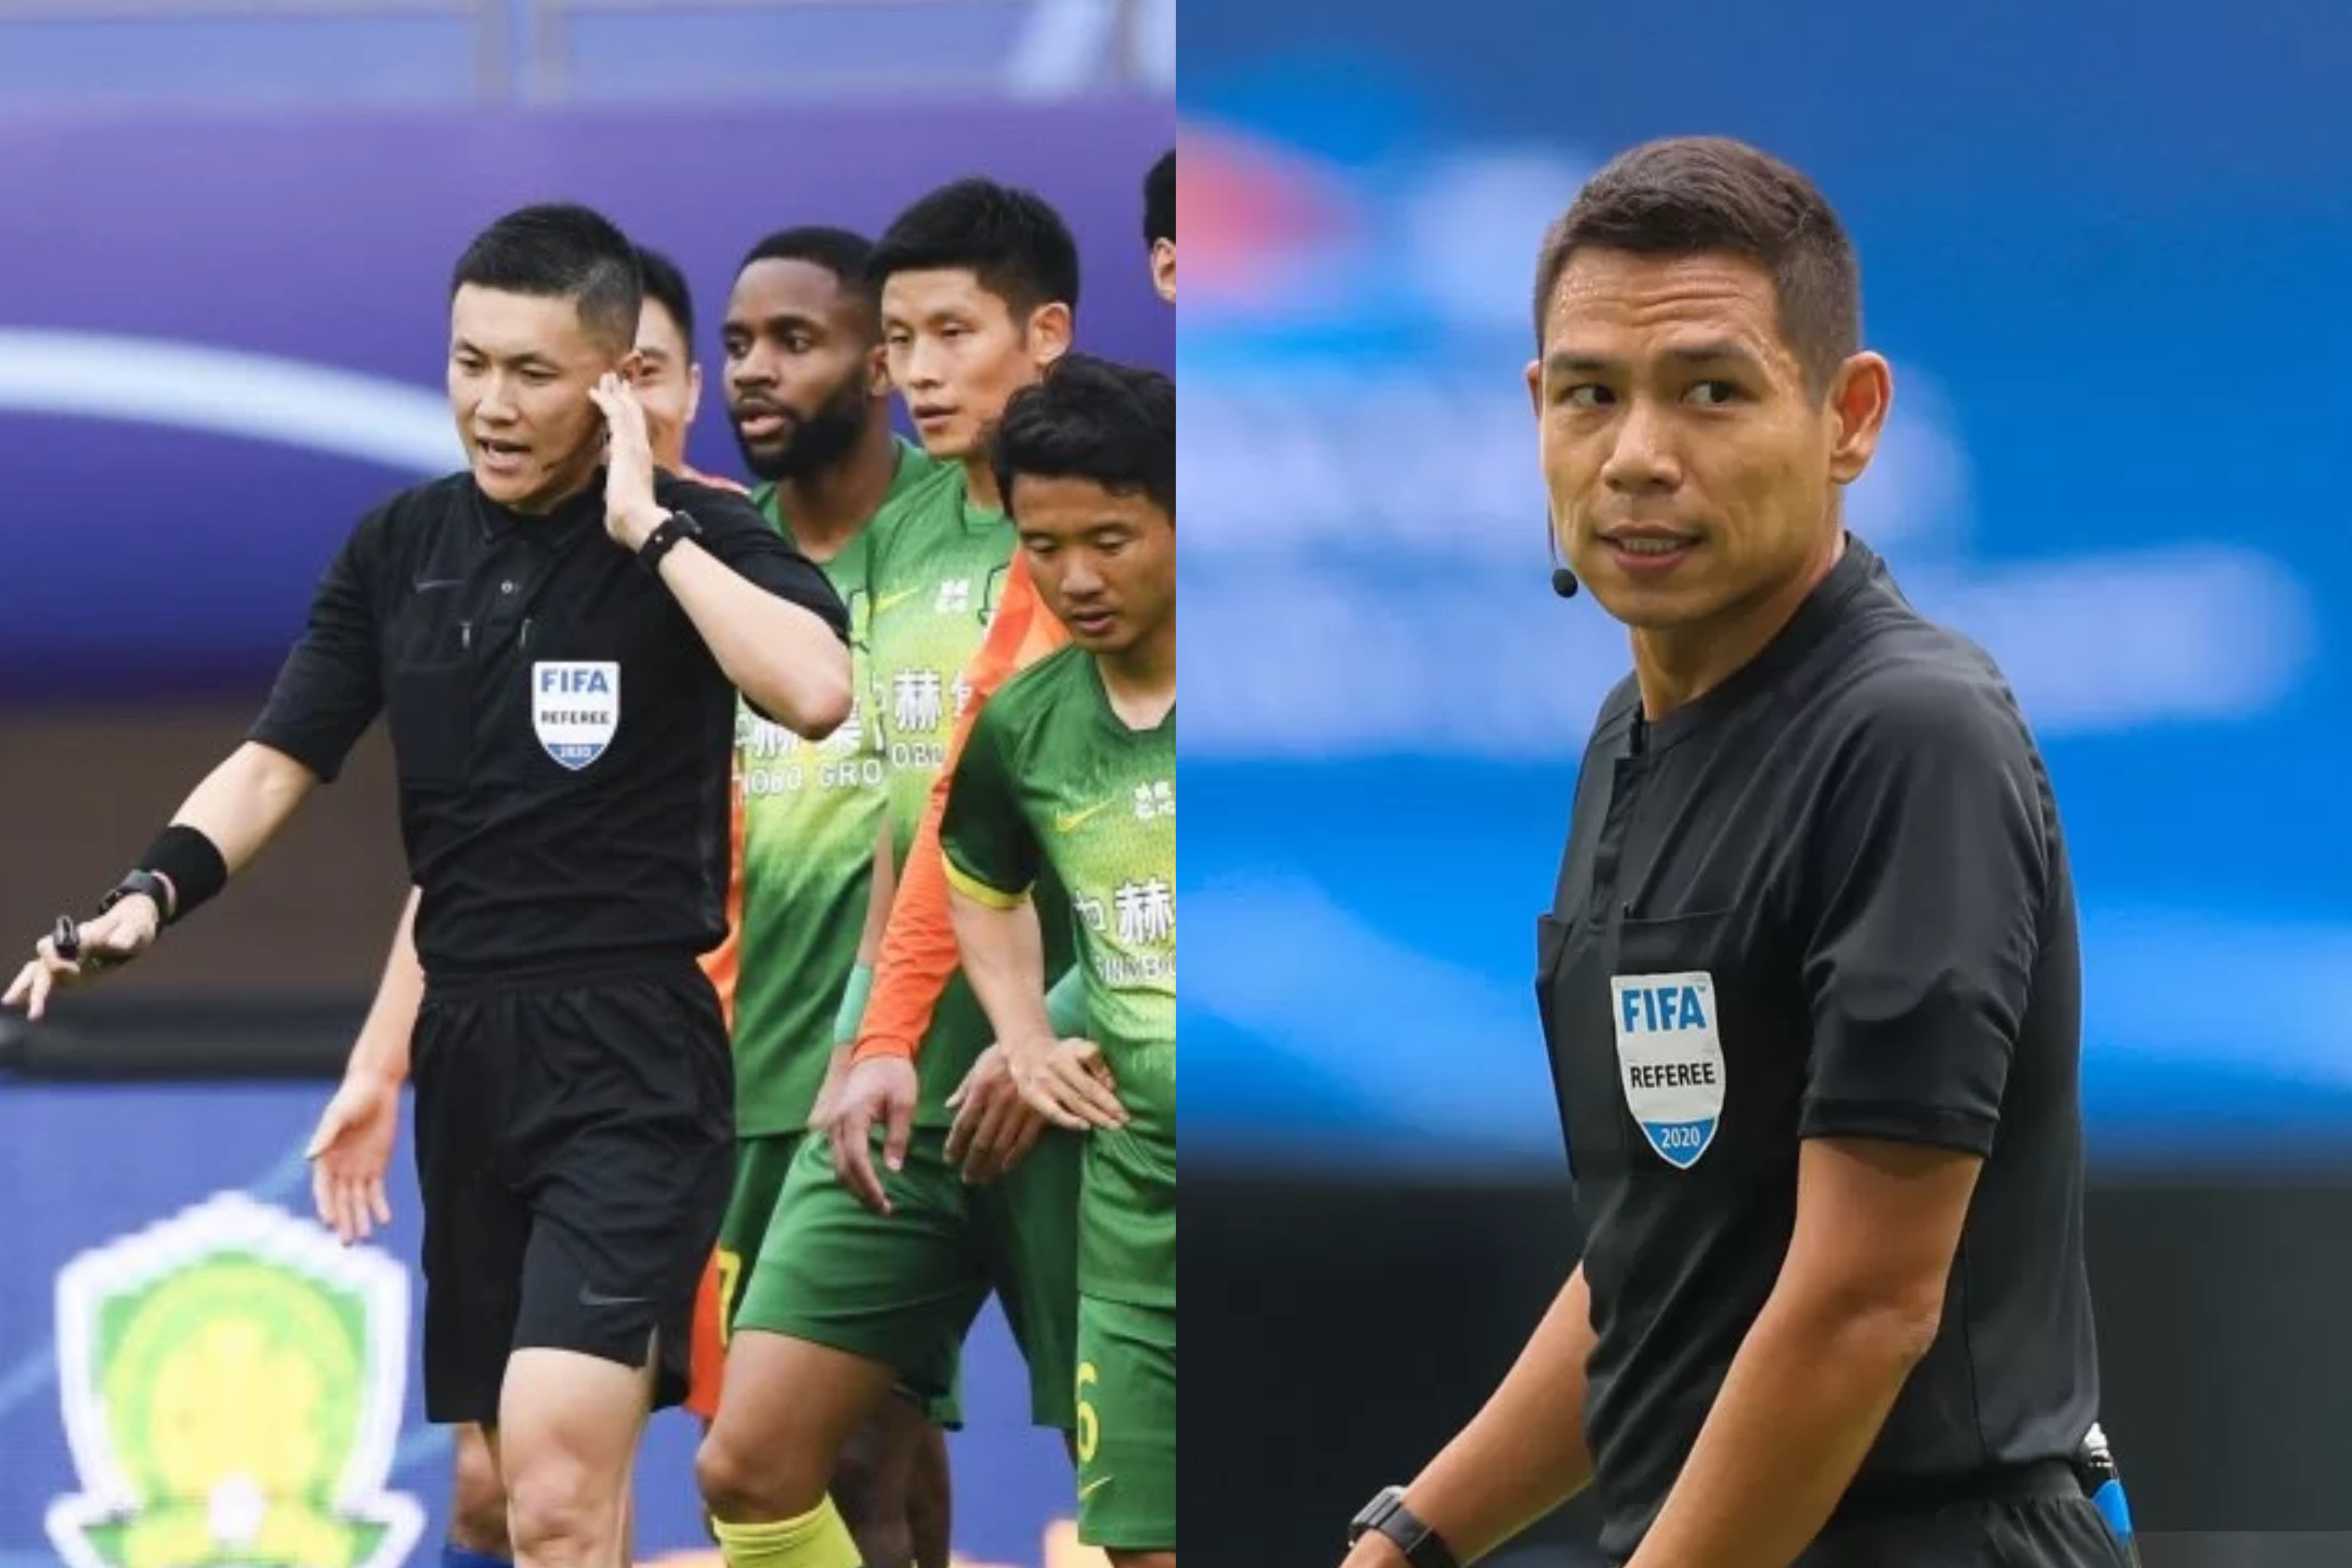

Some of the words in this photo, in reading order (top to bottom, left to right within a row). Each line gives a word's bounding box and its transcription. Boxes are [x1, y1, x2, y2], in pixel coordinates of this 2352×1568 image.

[540, 669, 608, 693] FIFA
[541, 710, 611, 725] REFEREE
[1621, 986, 1707, 1033] FIFA
[1630, 1063, 1716, 1088] REFEREE
[1660, 1127, 1701, 1149] 2020
